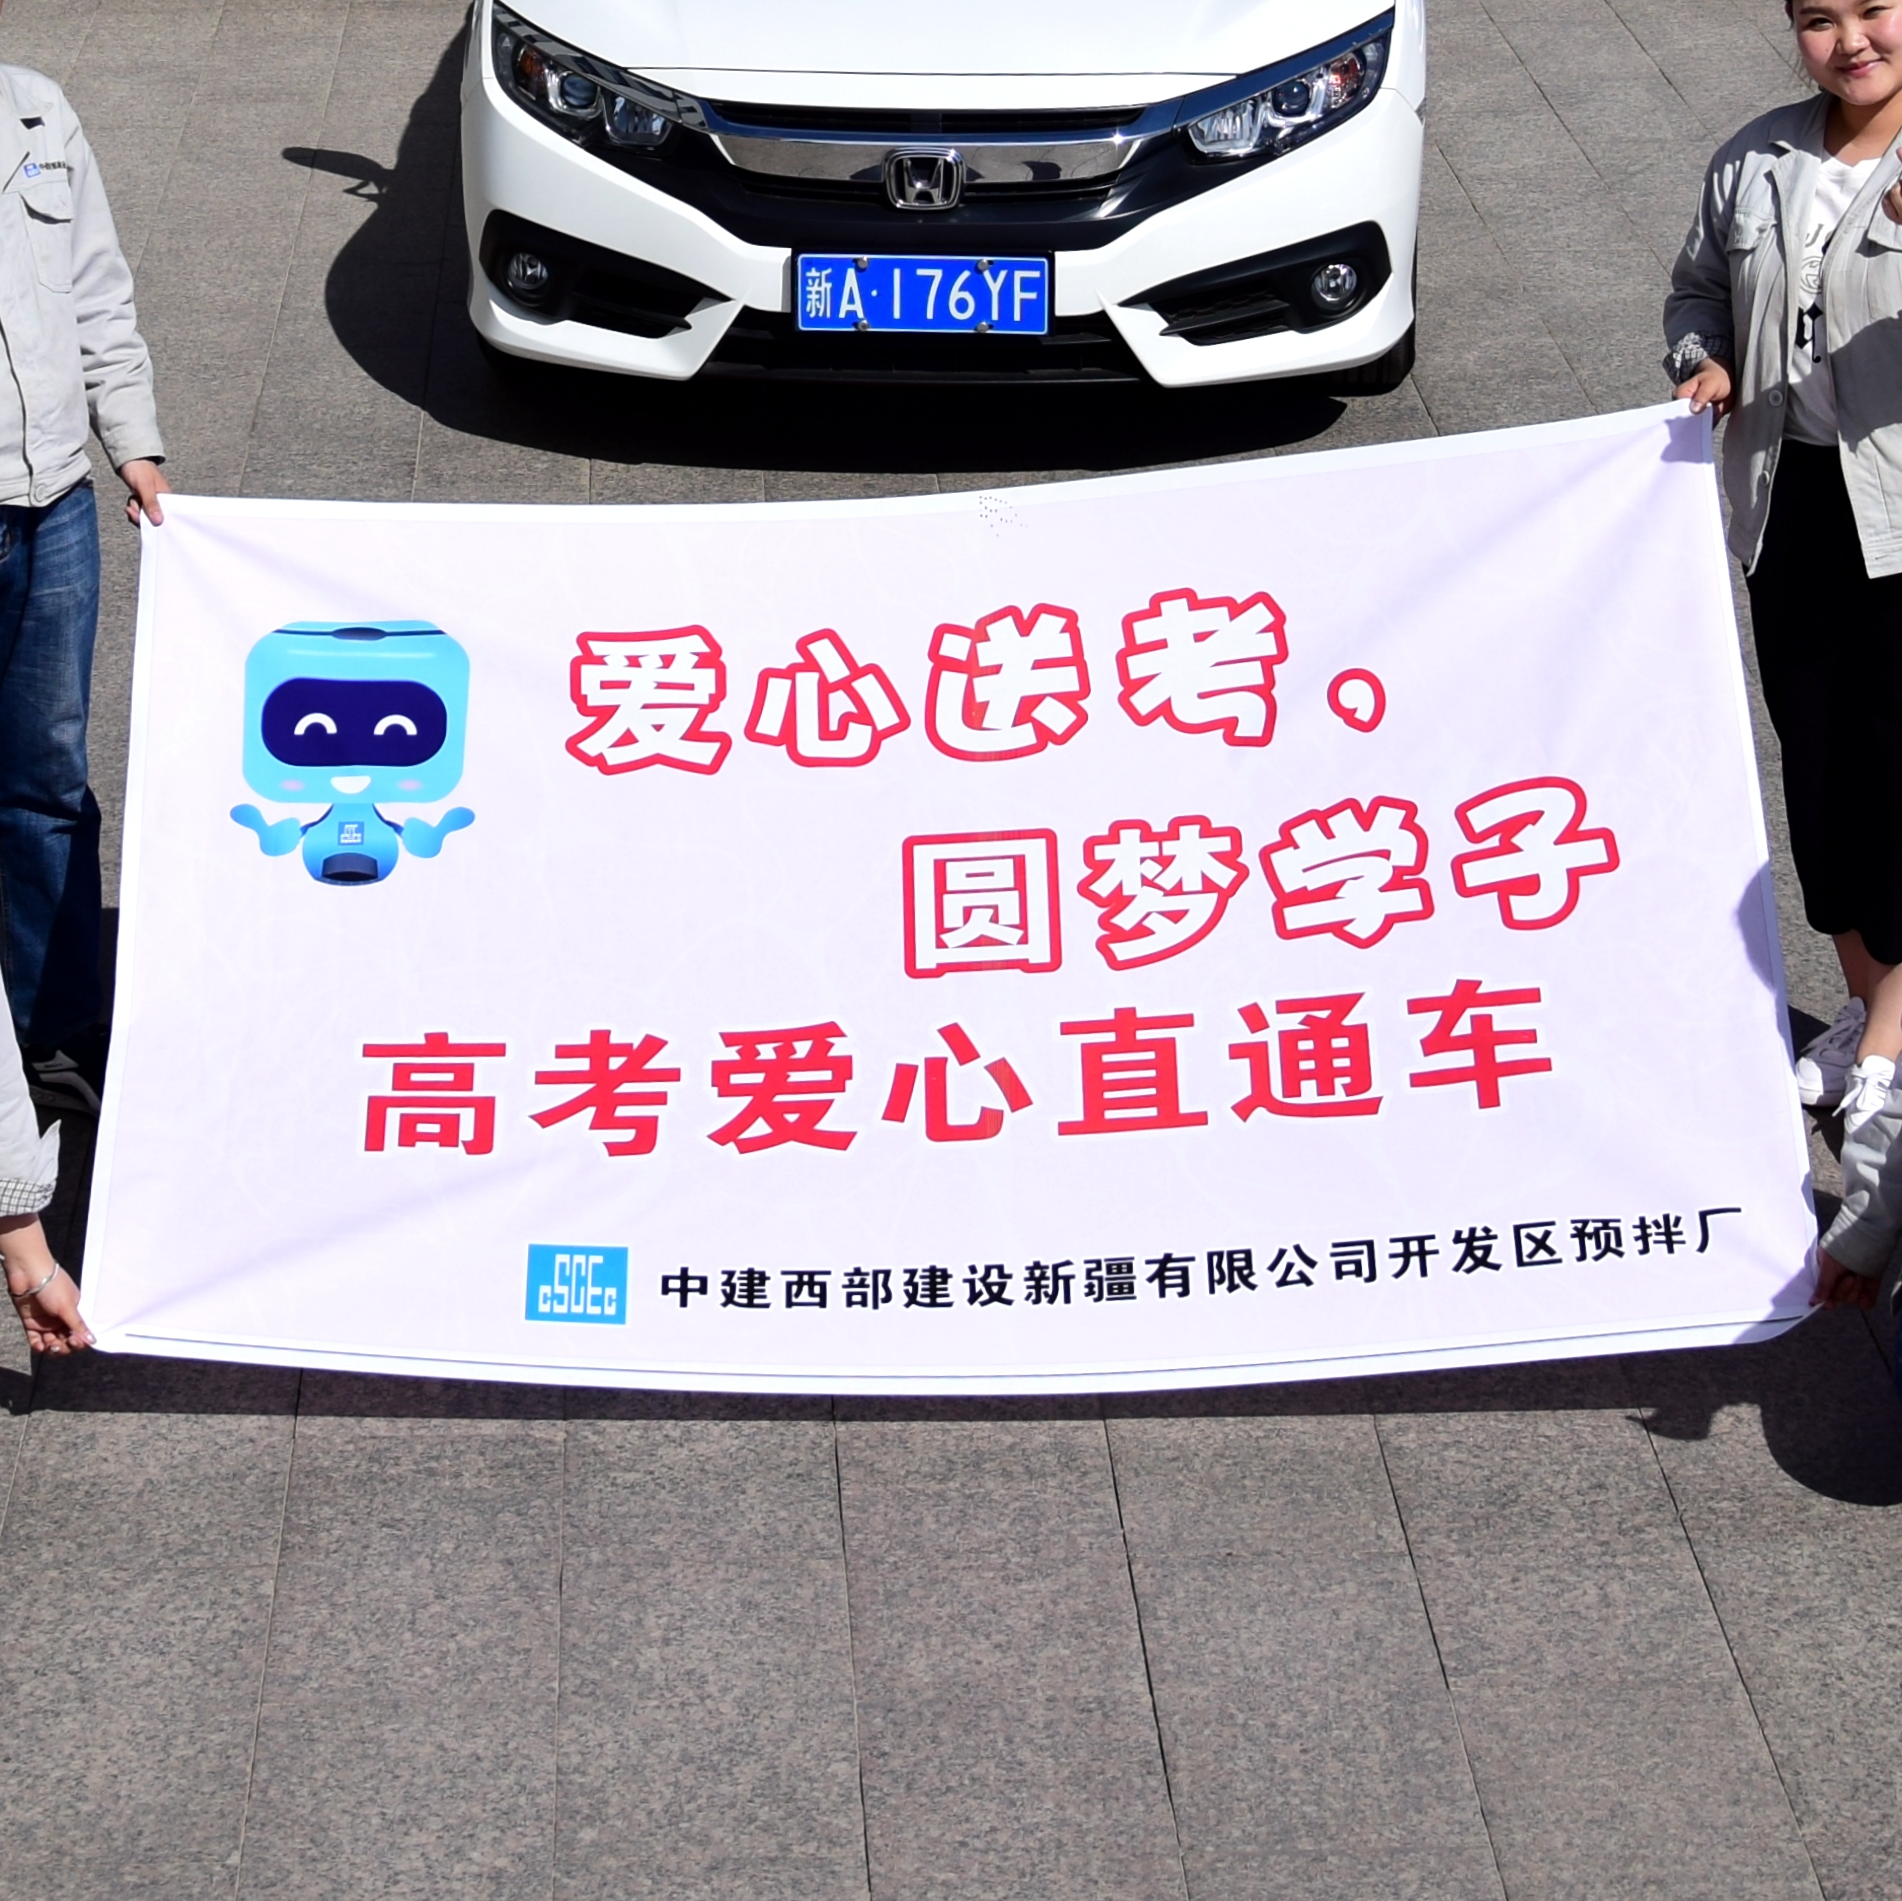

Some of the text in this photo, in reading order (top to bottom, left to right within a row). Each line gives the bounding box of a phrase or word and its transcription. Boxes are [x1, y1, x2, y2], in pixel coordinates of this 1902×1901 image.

[805, 266, 1041, 323] 新A·176YF
[902, 777, 1621, 980] 圆梦学子
[360, 980, 1555, 1158] 高考爱心直通车
[660, 1206, 1743, 1311] 中建西部建设新疆有限公司开发区预拌厂
